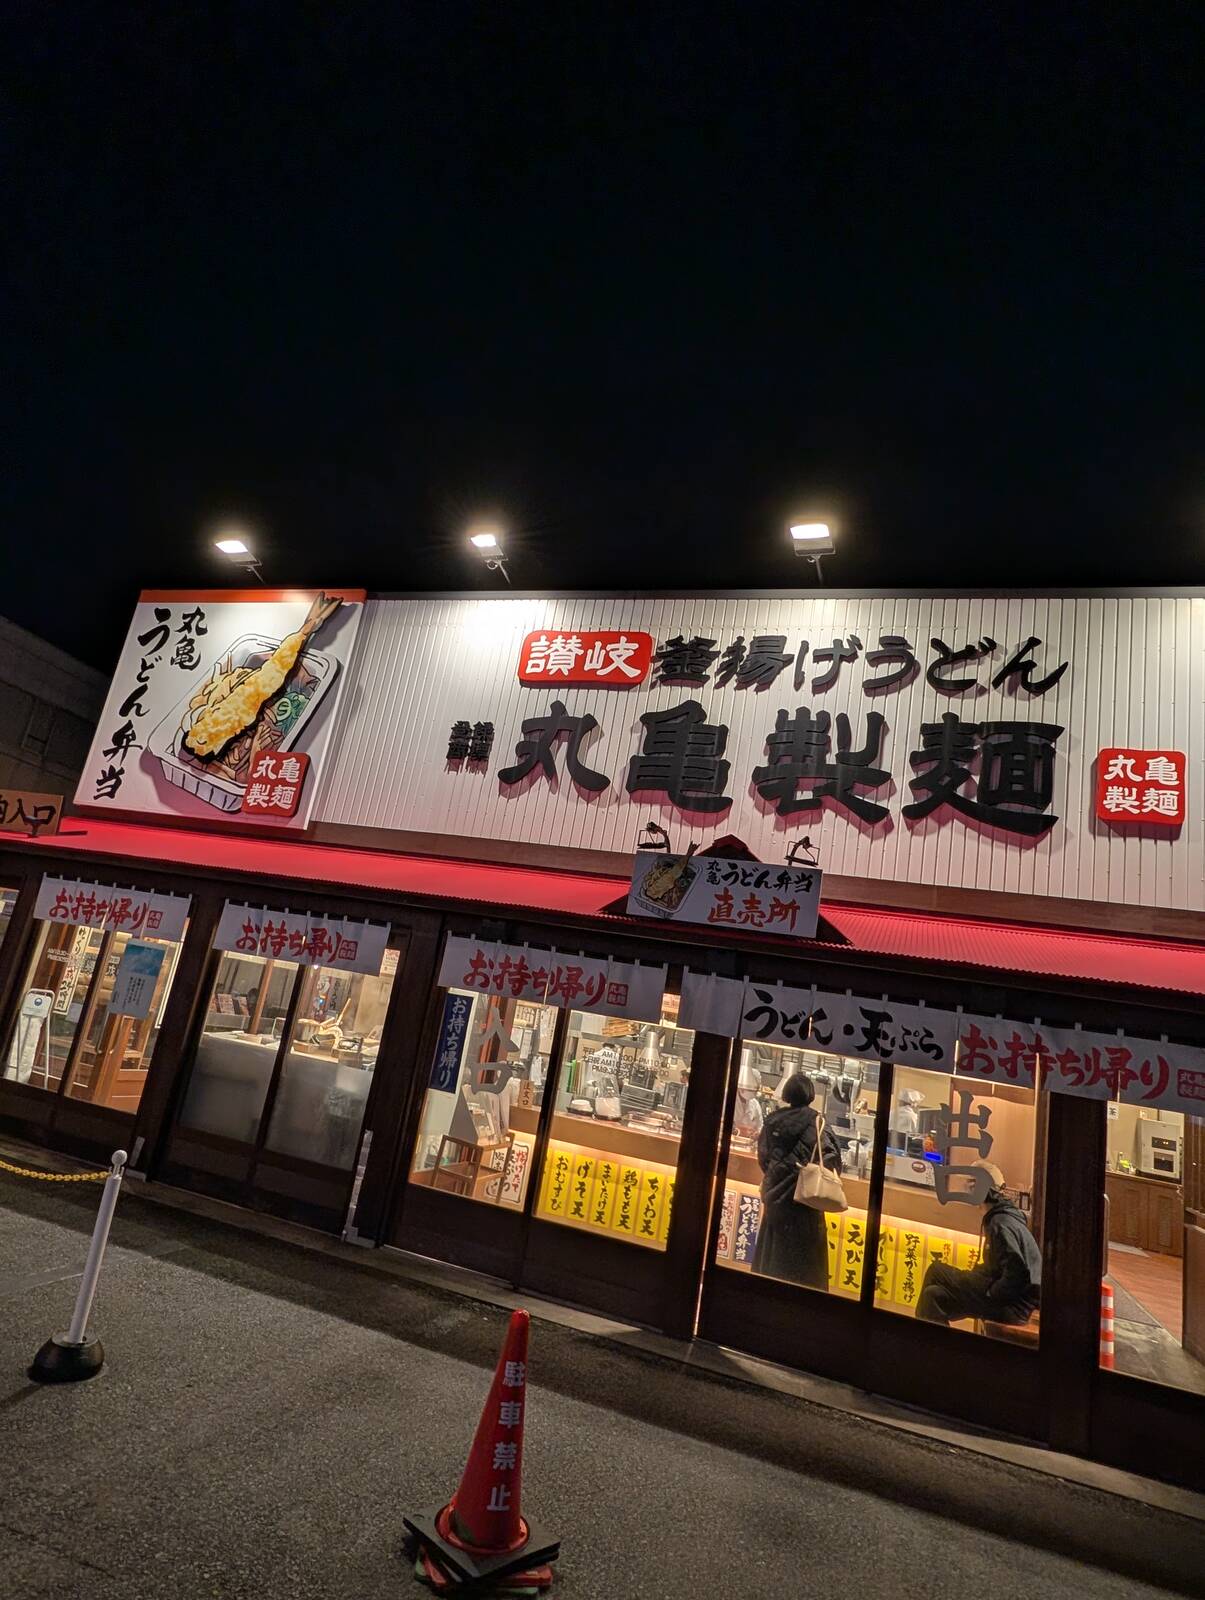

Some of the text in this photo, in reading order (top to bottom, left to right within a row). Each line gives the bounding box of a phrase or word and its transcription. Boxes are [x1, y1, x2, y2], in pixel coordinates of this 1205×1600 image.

[170, 606, 208, 671] 丸亀
[526, 635, 642, 678] 讃岐
[655, 634, 1068, 693] 釜揚げうどん
[93, 607, 170, 801] うどん弁当
[247, 783, 297, 809] 製麺
[252, 755, 302, 783] 丸亀
[498, 699, 1066, 837] 丸亀製麺
[1103, 754, 1180, 786] 丸亀
[1102, 785, 1179, 817] 製麺
[721, 861, 814, 894] うどん弁当
[49, 888, 148, 931] お持ち帰り
[706, 886, 800, 932] 直売所
[236, 918, 342, 963] お持ち帰り
[463, 949, 607, 1008] お持ち帰り
[439, 996, 468, 1090] お持ち帰り
[470, 1006, 521, 1096] 入口
[743, 988, 945, 1062] うどん・天ぷら
[958, 1022, 1171, 1101] お持ち帰り
[934, 1089, 997, 1206] 出口
[550, 1155, 569, 1211] おむすび
[570, 1160, 593, 1218] げそ天
[593, 1163, 612, 1225] まいたけ天
[616, 1169, 638, 1230] 鶏もも天
[639, 1176, 660, 1236] ちくわ天
[735, 1196, 753, 1261] うどん弁当
[843, 1223, 865, 1289] えび天
[902, 1233, 921, 1304] 野菜かき揚げ
[486, 1360, 527, 1513] 駐車禁止
